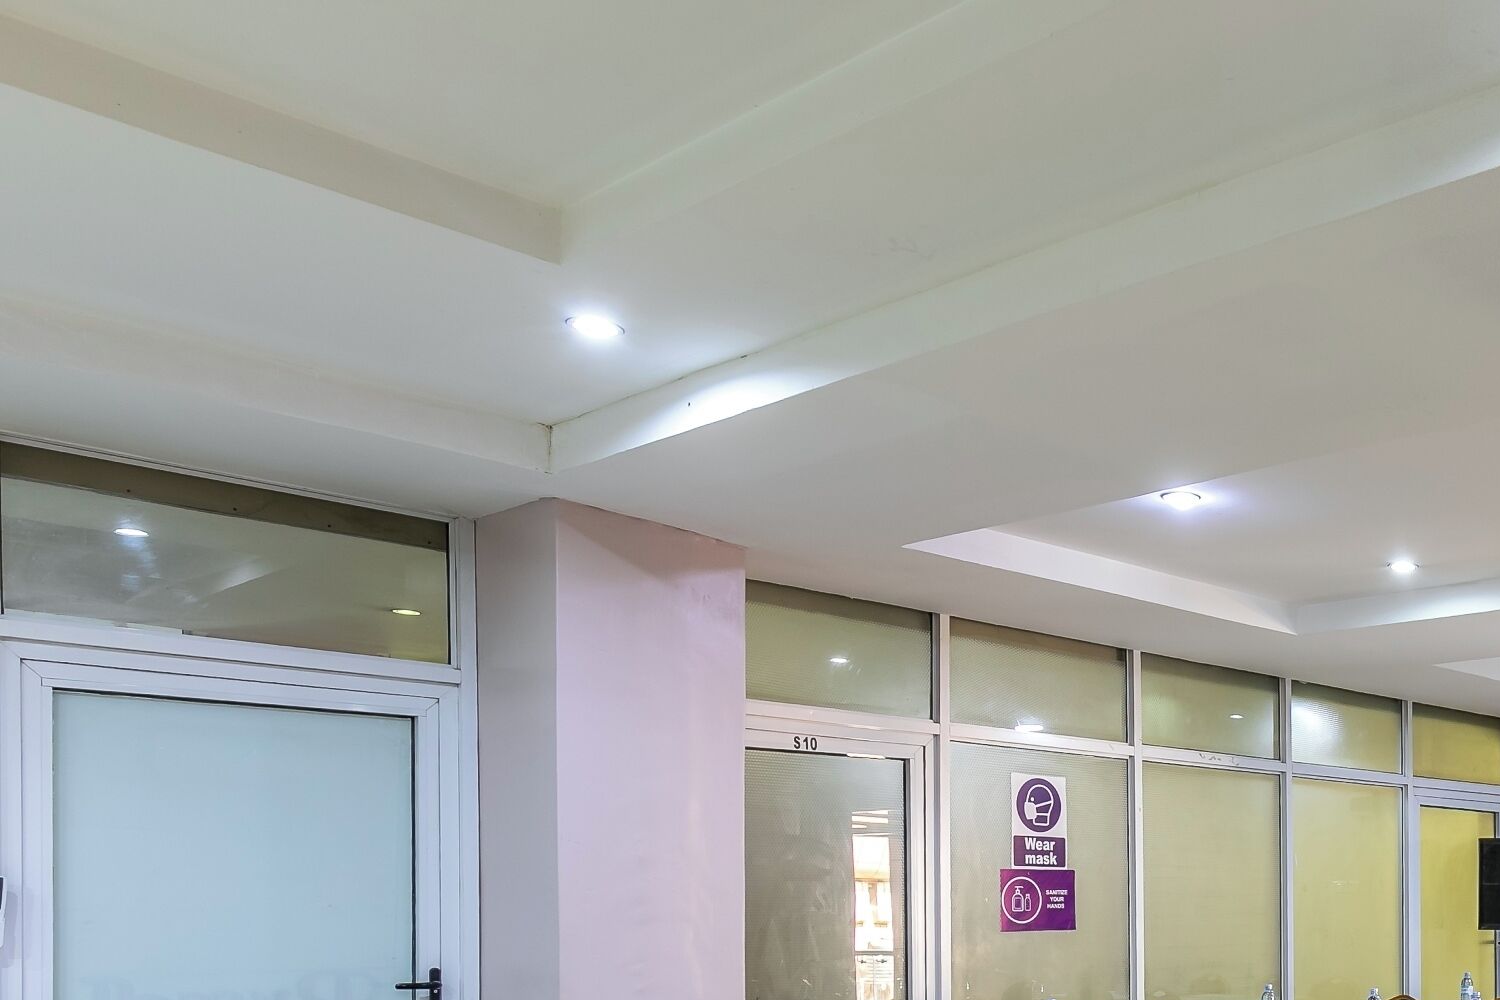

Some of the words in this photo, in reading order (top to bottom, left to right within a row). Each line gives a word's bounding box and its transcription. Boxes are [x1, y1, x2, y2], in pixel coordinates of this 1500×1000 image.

[793, 736, 818, 751] S10
[1024, 837, 1056, 851] Wear
[1024, 852, 1058, 865] mask
